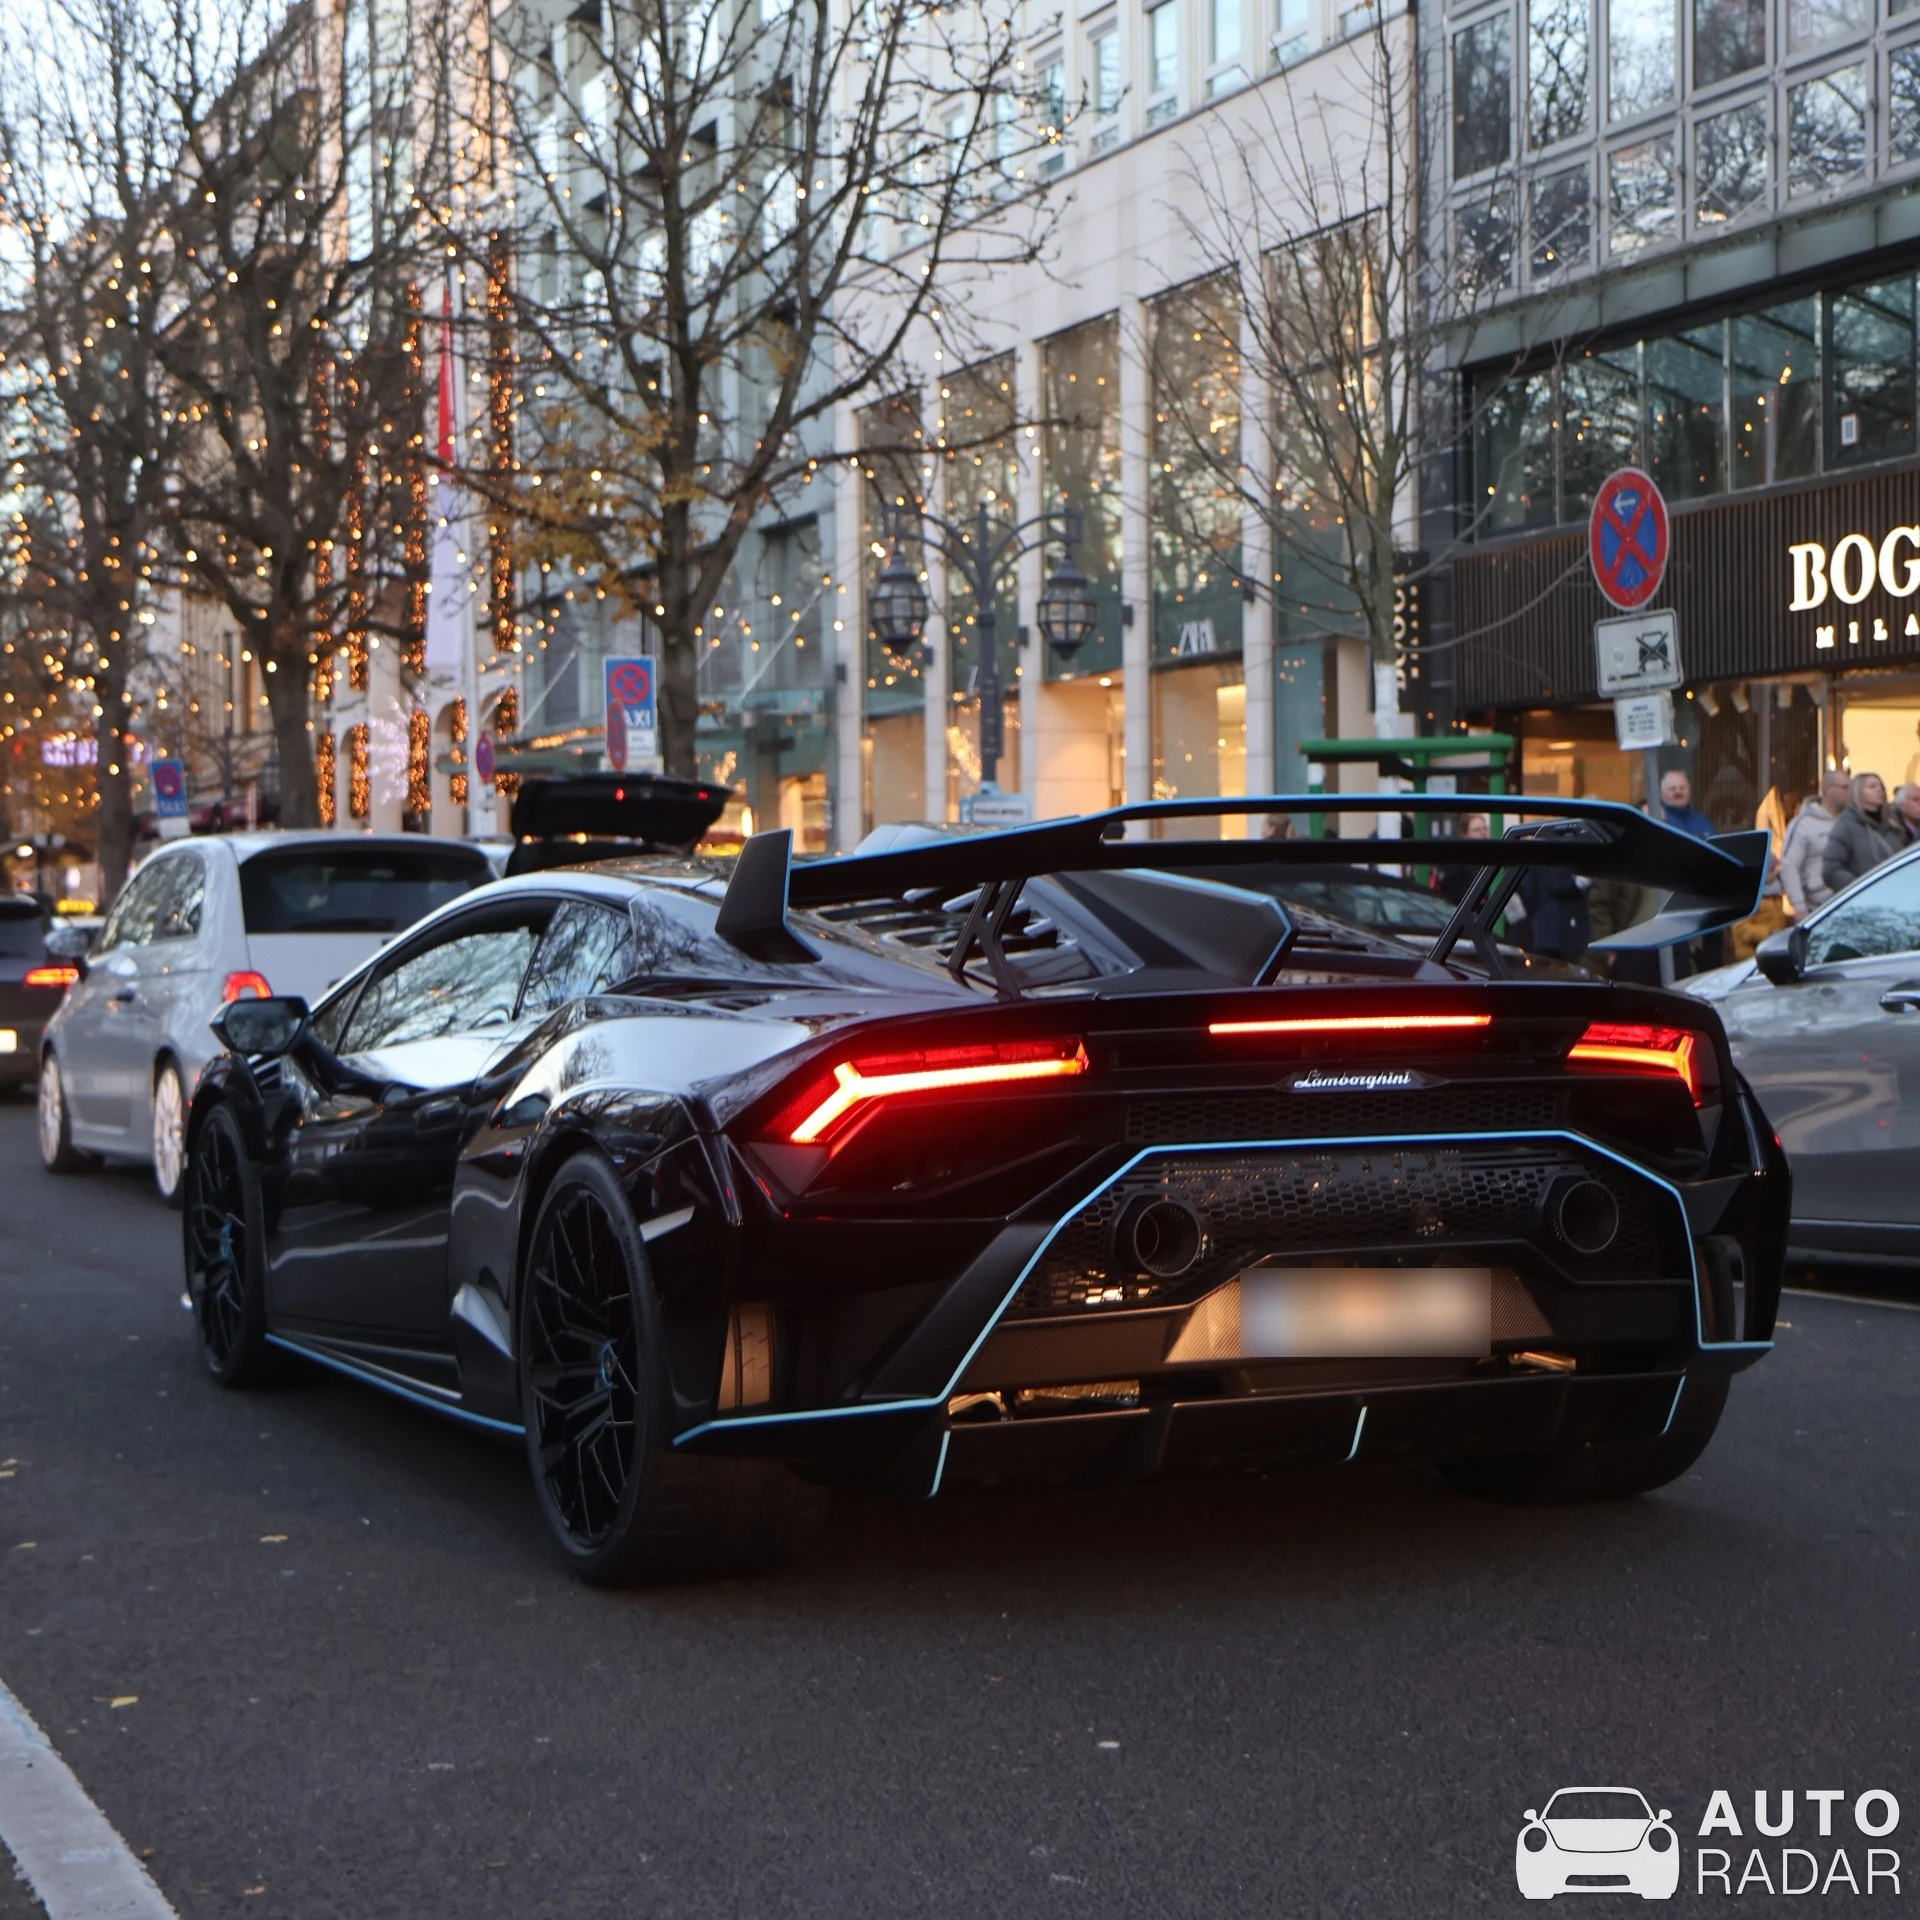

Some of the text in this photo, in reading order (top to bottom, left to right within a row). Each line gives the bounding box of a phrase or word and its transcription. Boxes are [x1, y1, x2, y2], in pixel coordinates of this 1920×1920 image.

[1788, 525, 1920, 612] BOG
[1816, 613, 1920, 649] MILA
[1294, 1069, 1412, 1089] Lamborghini
